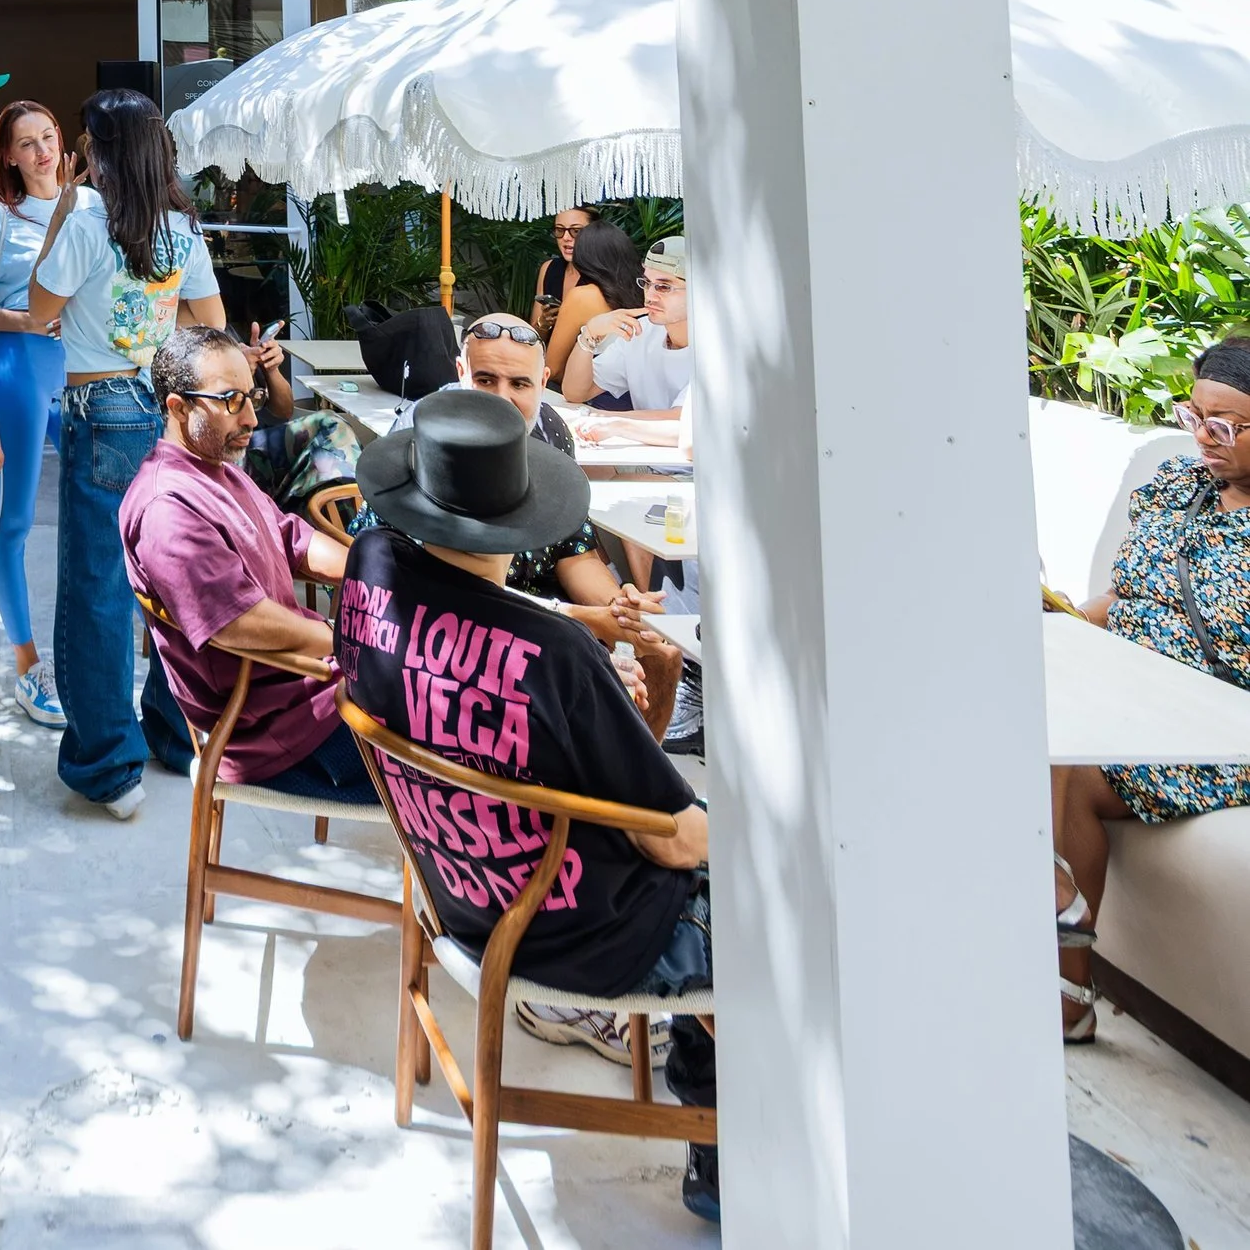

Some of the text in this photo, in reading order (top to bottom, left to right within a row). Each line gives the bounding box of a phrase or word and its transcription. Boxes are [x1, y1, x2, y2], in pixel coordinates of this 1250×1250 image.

[351, 611, 400, 655] MARCH
[405, 604, 542, 704] LOUIE
[402, 668, 530, 769] VEGA
[430, 848, 490, 909] DJ
